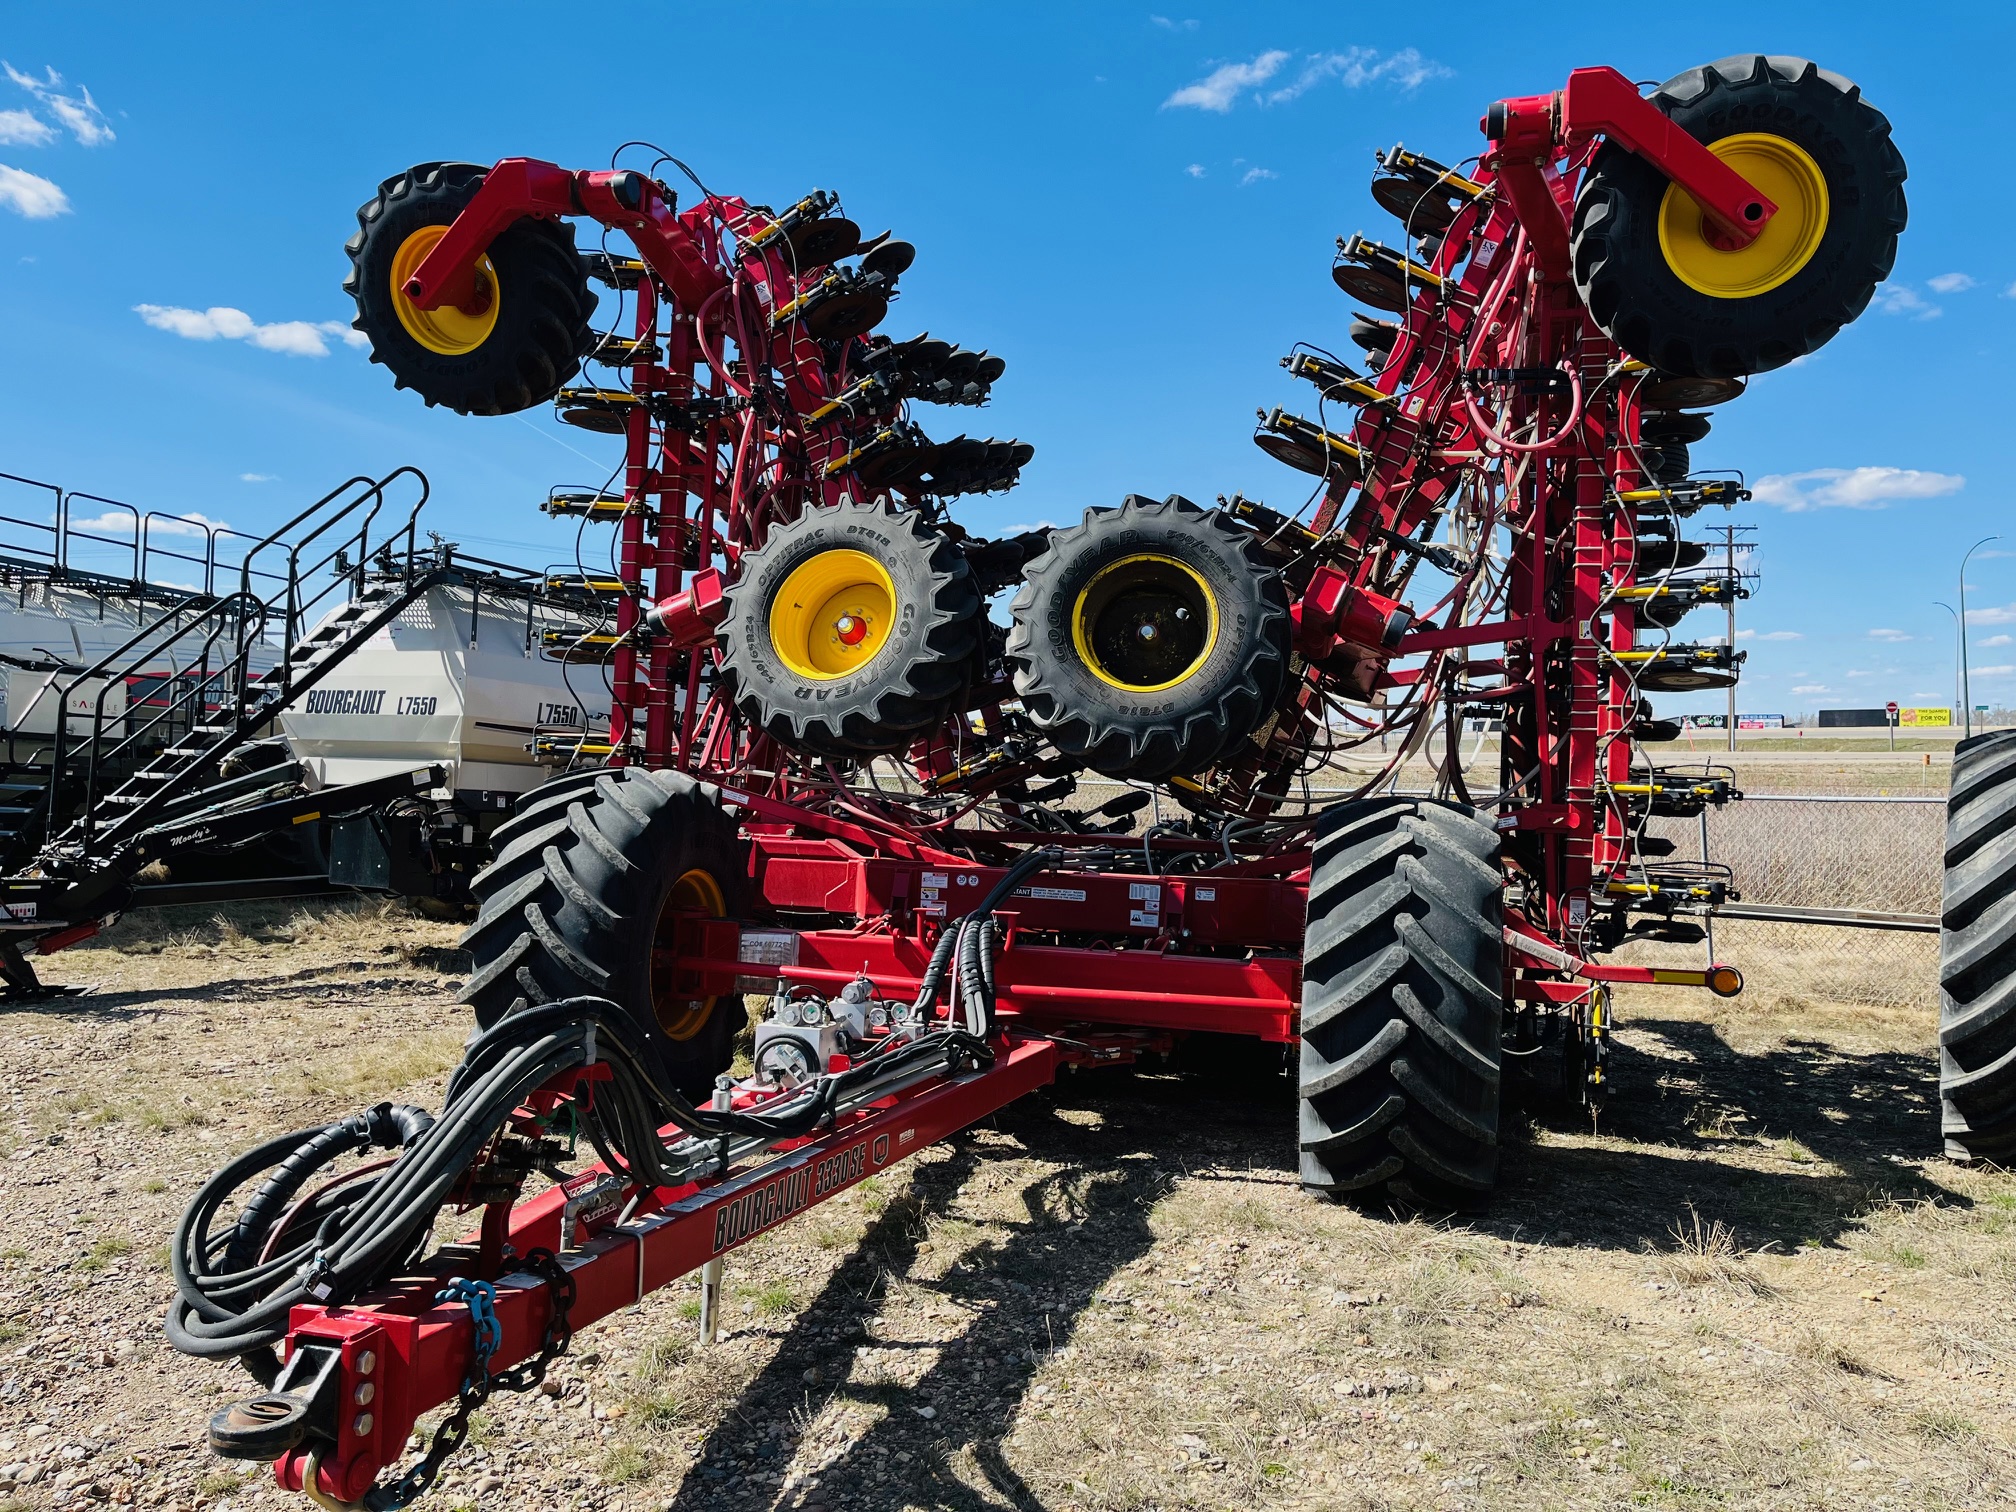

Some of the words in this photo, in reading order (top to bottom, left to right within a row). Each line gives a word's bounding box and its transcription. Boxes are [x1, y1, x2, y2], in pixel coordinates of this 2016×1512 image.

[758, 528, 824, 586] OPTITRAC
[846, 525, 891, 547] DT818
[1166, 529, 1236, 583] 540/65R24
[1048, 530, 1140, 663] GOODYEAR
[745, 615, 776, 684] 540/65R24
[794, 603, 915, 702] GOODYEAR
[1198, 613, 1247, 696] OPTITRAC
[72, 700, 118, 711] SADLE
[306, 690, 386, 715] BOURGAULT
[397, 696, 438, 716] L7550
[537, 702, 578, 726] L7550
[1118, 702, 1175, 716] DT818
[170, 826, 211, 846] Moody's
[713, 1164, 813, 1254] BOURGAULT
